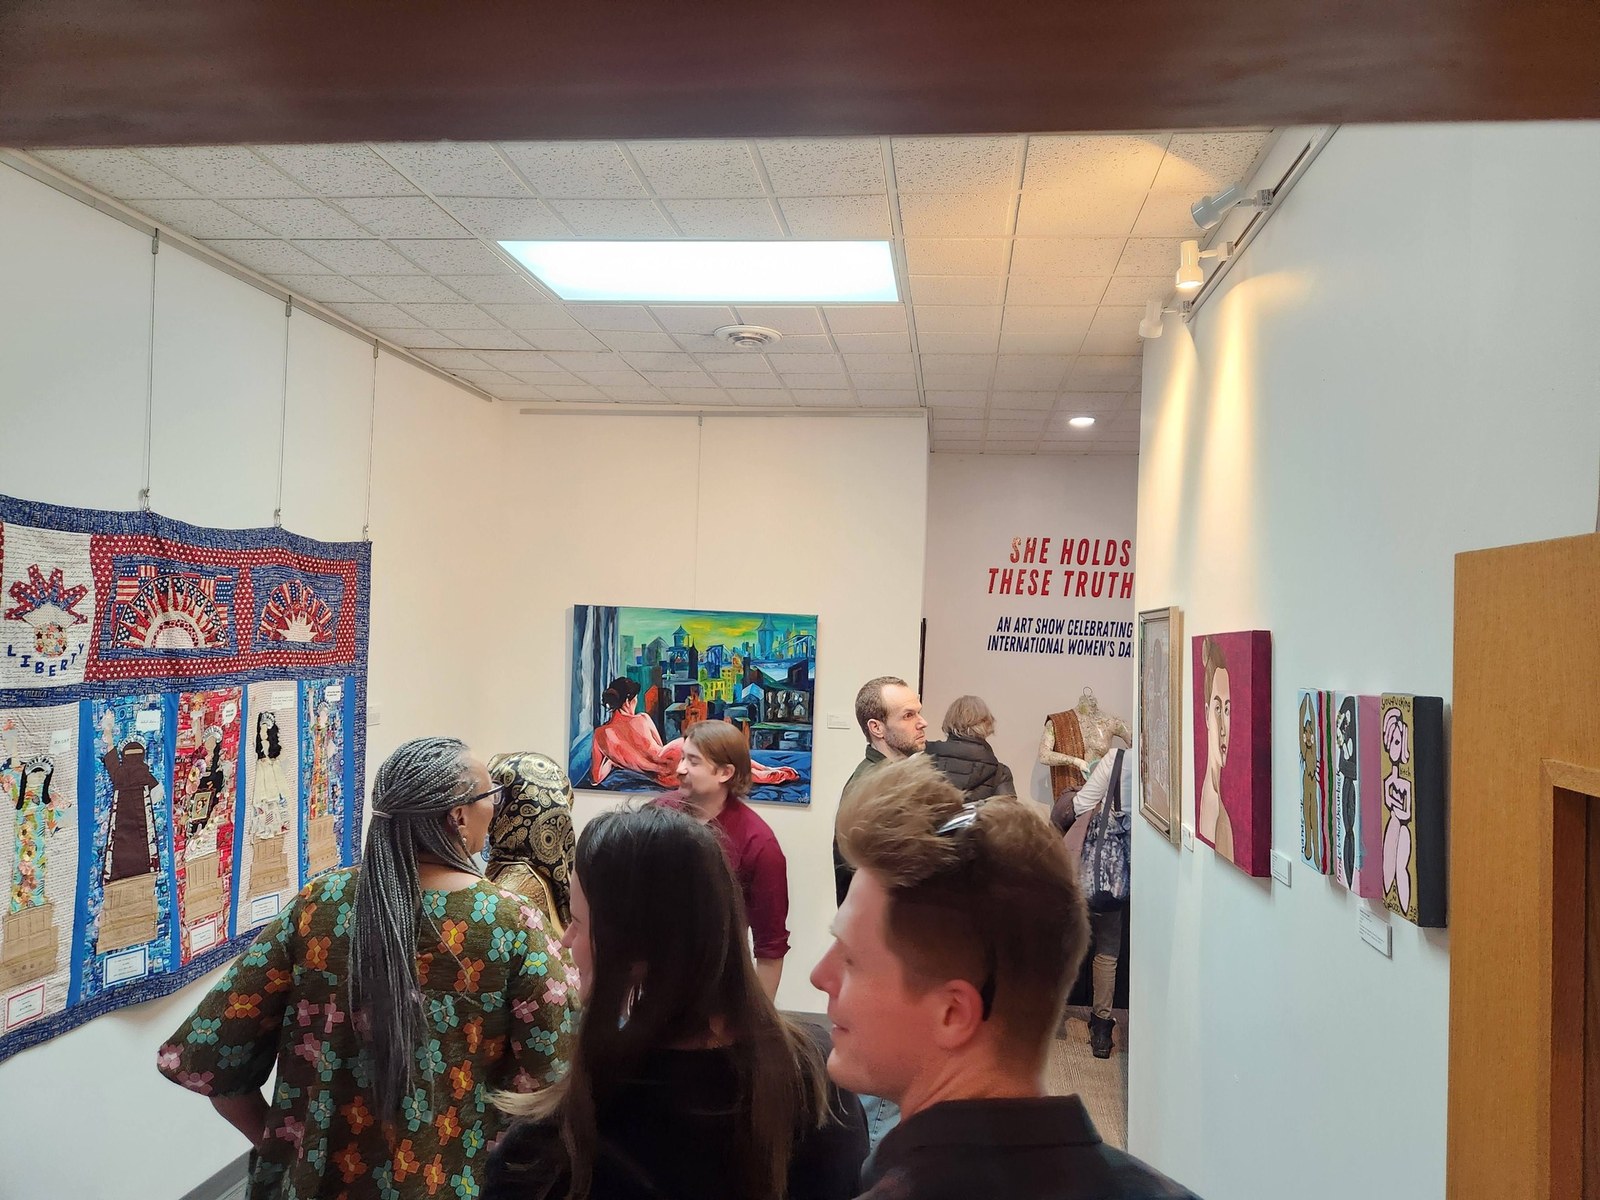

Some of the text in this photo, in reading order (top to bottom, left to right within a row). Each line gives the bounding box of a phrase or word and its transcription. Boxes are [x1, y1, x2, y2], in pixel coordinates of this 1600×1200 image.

[1010, 537, 1132, 567] SHE HOLDS
[988, 568, 1053, 596] THESE
[997, 616, 1134, 638] AN ART SHOW CELEBRATING
[7, 643, 84, 677] LIBERTY
[987, 635, 1135, 658] INTERNATIONAL WOMEN'S DA
